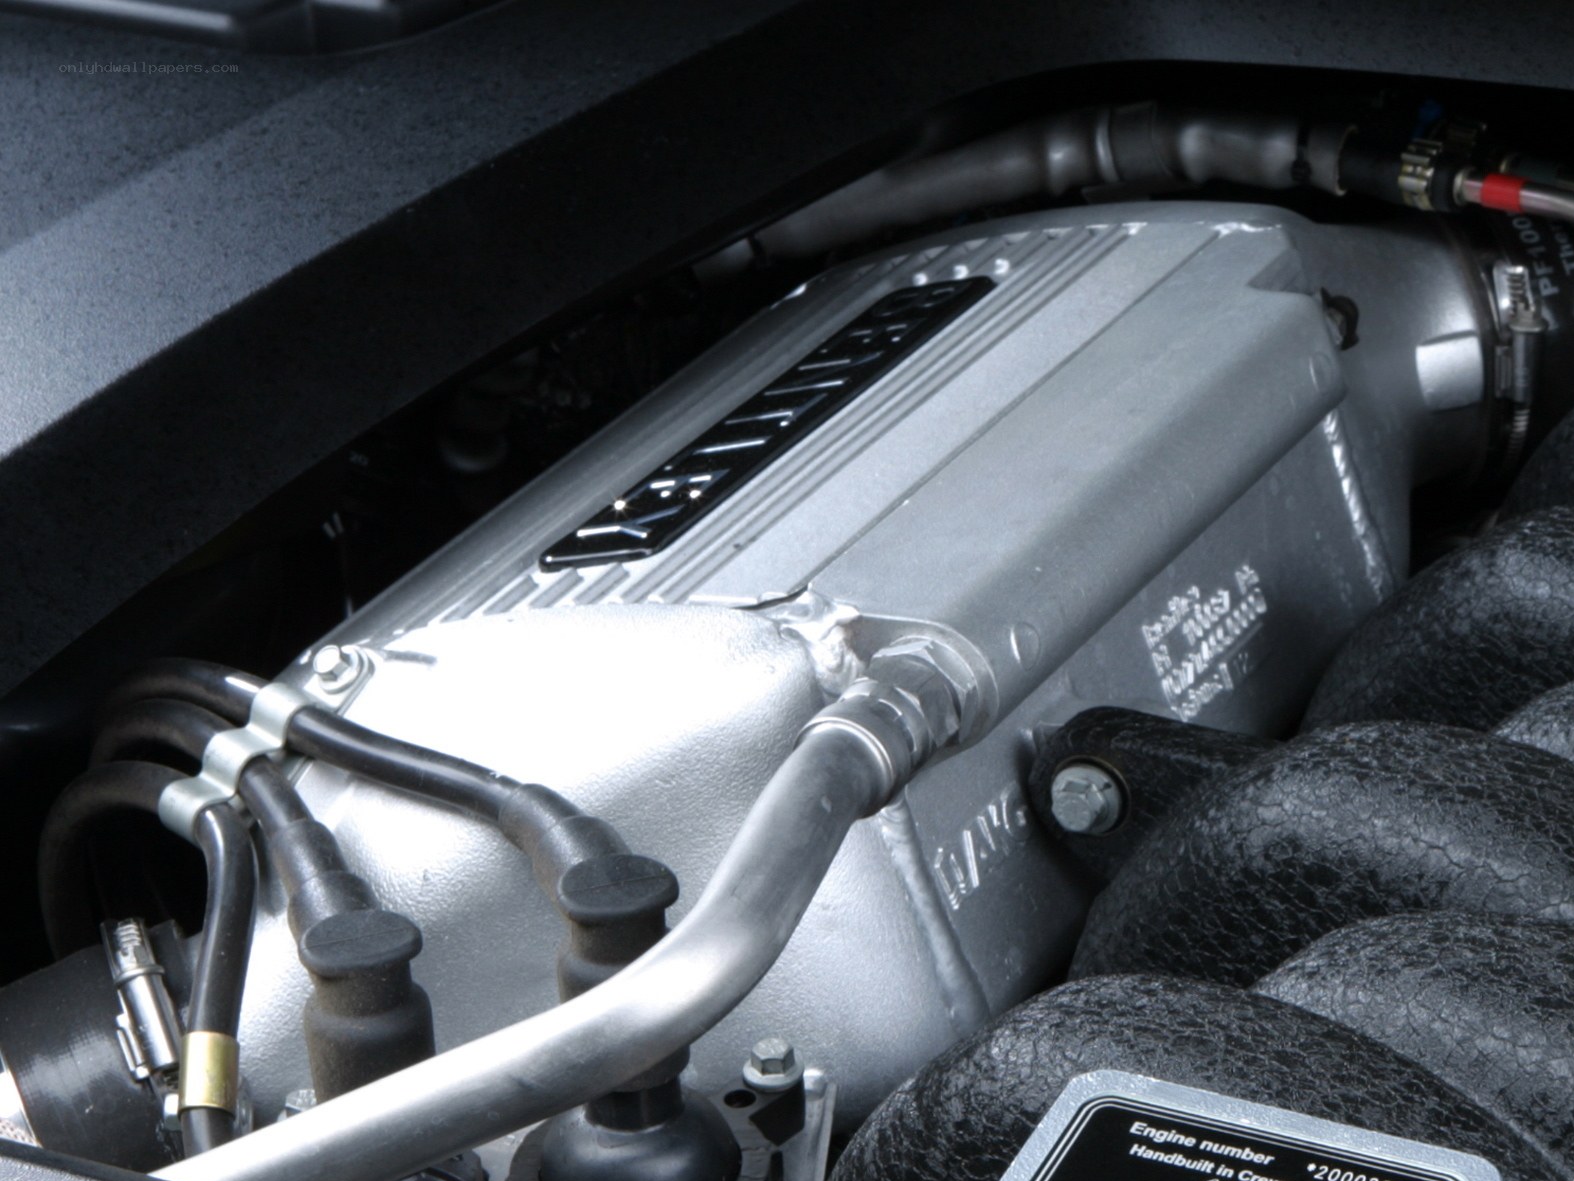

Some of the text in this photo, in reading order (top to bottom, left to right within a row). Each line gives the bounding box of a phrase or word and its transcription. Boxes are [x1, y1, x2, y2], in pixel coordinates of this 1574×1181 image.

[1510, 212, 1560, 297] PF100
[1130, 1122, 1196, 1147] Engine
[1200, 1141, 1274, 1165] number
[1130, 1144, 1214, 1174] Handbuilt
[1216, 1165, 1234, 1179] in
